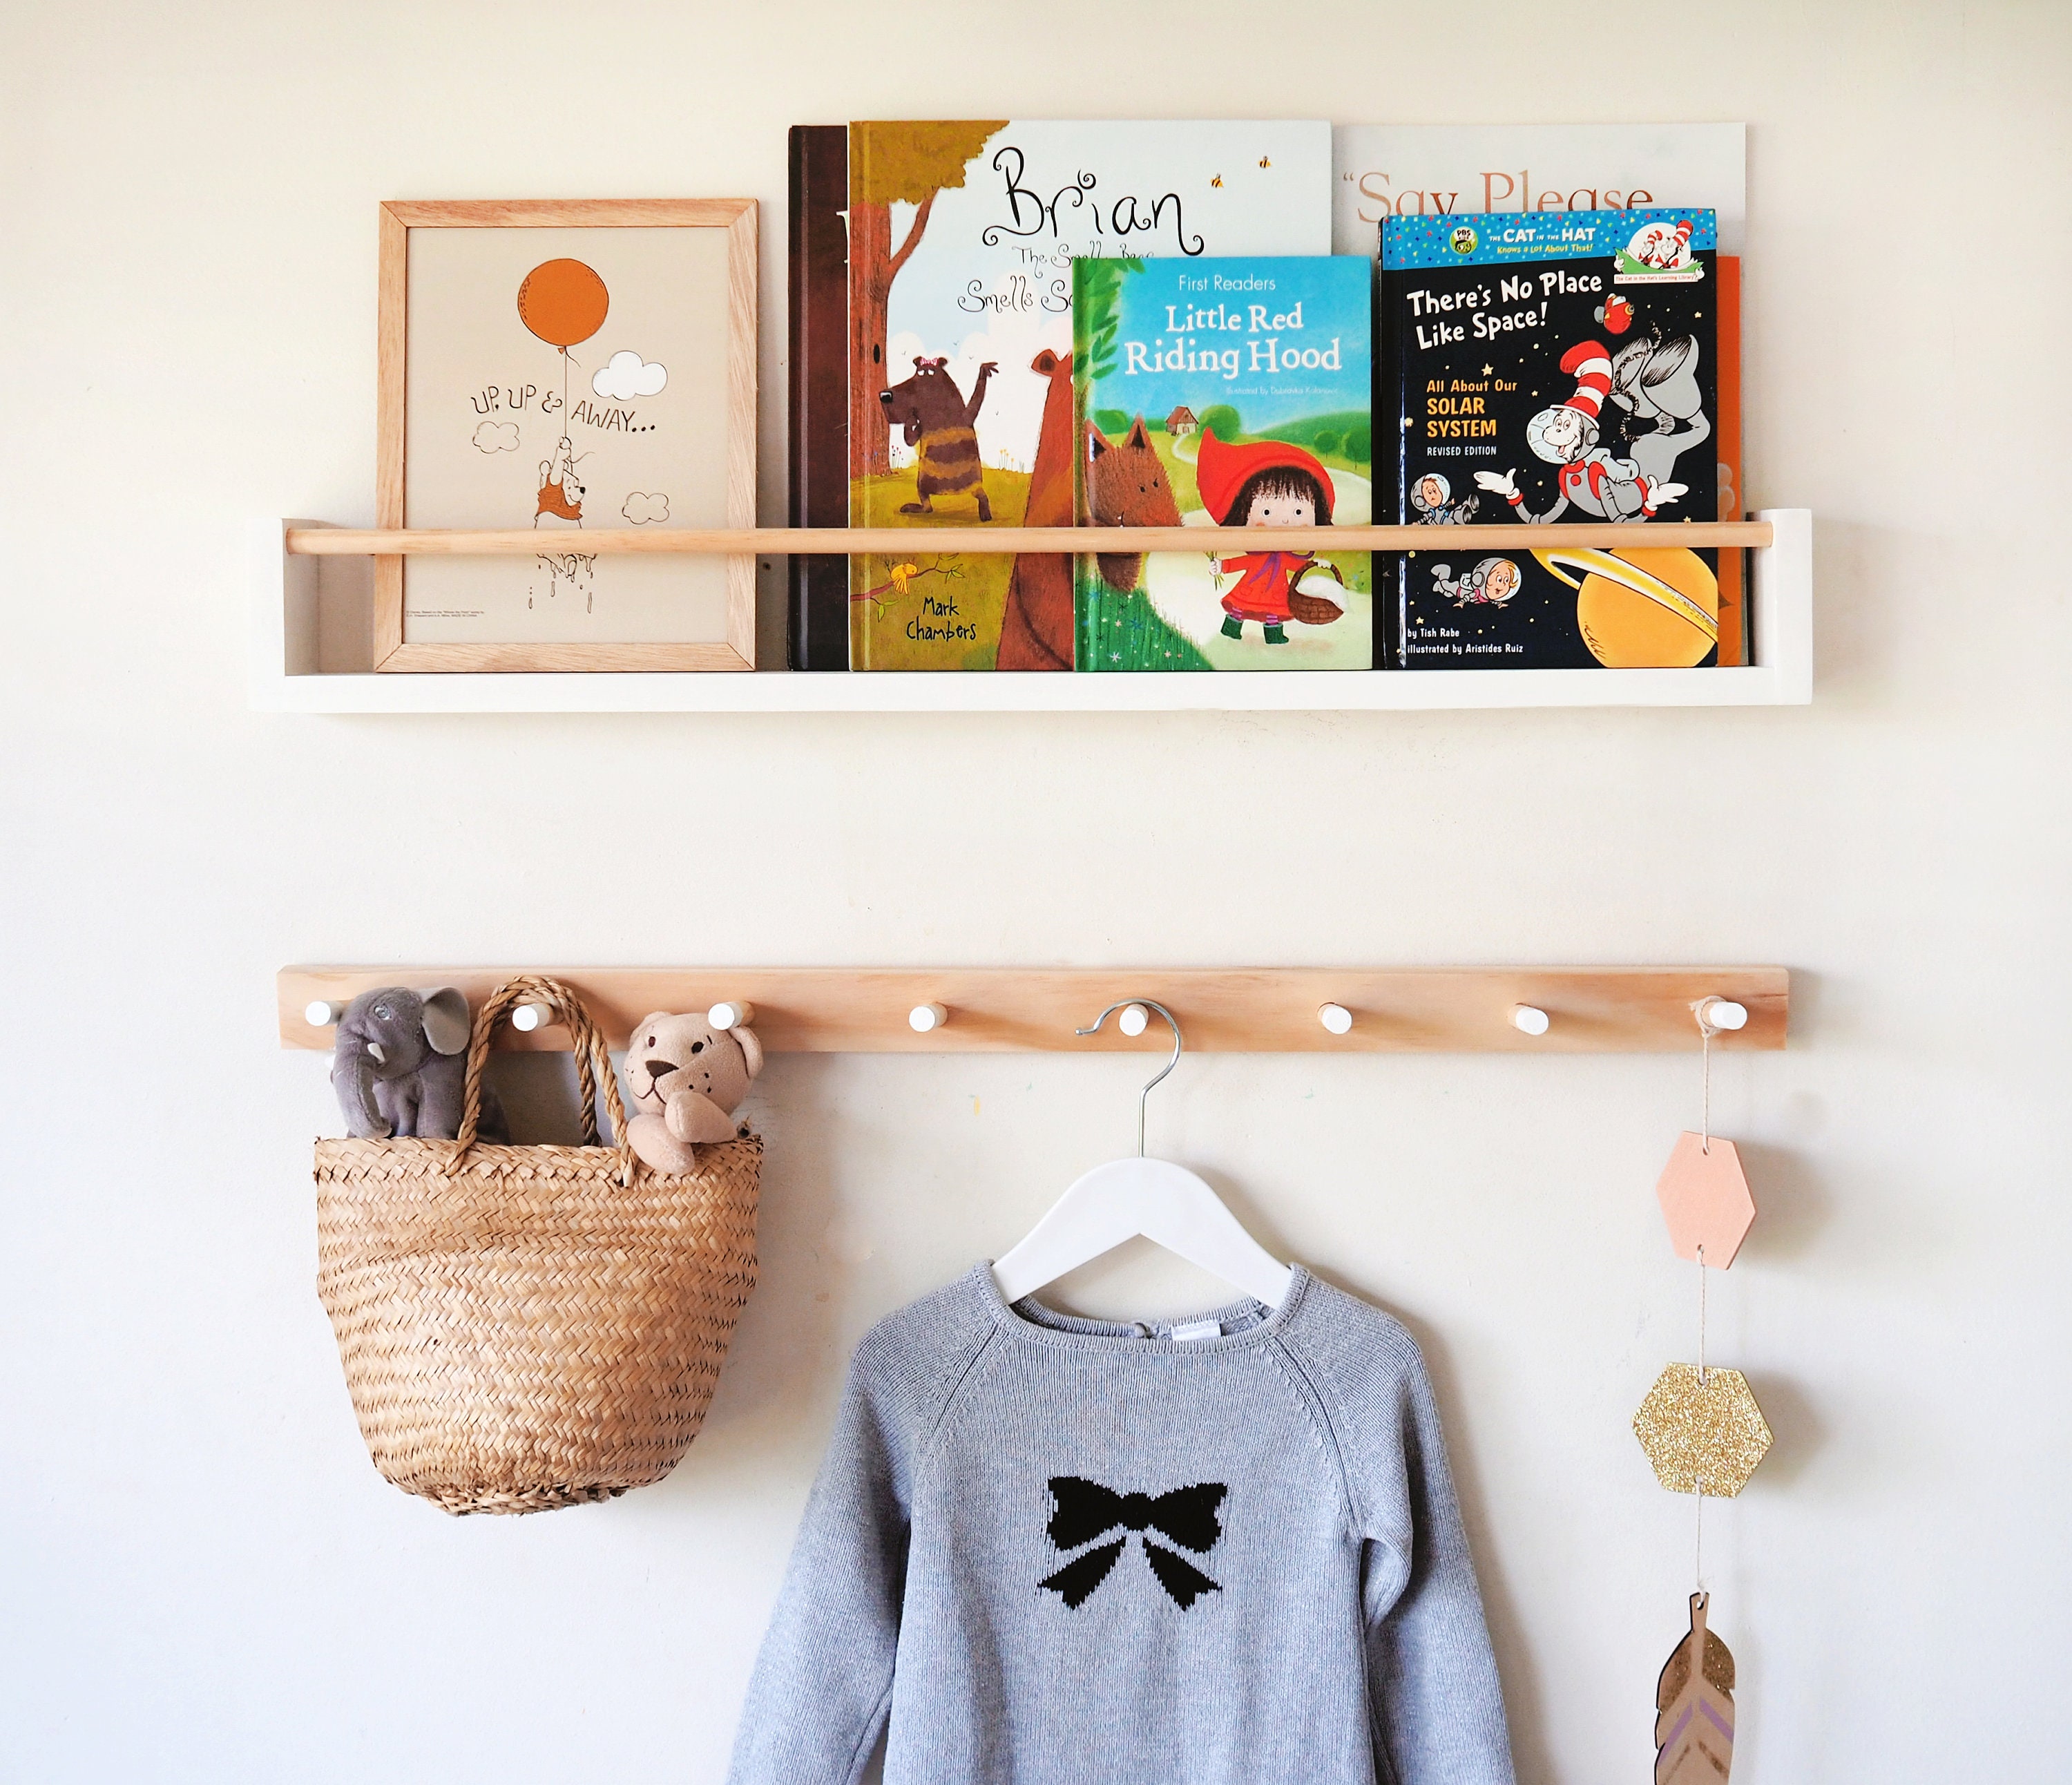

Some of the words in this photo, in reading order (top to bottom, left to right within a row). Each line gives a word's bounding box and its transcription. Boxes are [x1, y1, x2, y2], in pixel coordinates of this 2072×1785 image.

[982, 146, 1204, 256] Brian
[1503, 229, 1537, 242] CAT
[1562, 227, 1595, 241] HAT
[1497, 246, 1522, 254] Knows
[1531, 245, 1542, 254] Lot
[1545, 244, 1568, 253] About
[1012, 246, 1047, 278] The
[1179, 275, 1208, 291] First
[1214, 274, 1276, 291] Readers
[1406, 284, 1491, 316] There's
[1500, 274, 1533, 303] No
[1539, 270, 1602, 296] Place
[957, 276, 1033, 314] Smells
[1165, 303, 1241, 332] Little
[1248, 301, 1304, 333] Red
[1416, 321, 1465, 350] Like
[1473, 301, 1548, 341] Space!
[1124, 336, 1240, 379] Riding
[1247, 337, 1343, 373] Hood
[1426, 380, 1443, 392] All
[1450, 379, 1488, 392] About
[1495, 379, 1517, 391] Our
[508, 385, 536, 410] UP
[541, 391, 563, 413] &
[1427, 397, 1485, 415] SOLAR
[1427, 419, 1497, 438] SYSTEM
[1427, 446, 1461, 456] REVISED
[1465, 446, 1497, 455] EDITION
[922, 595, 959, 616] Mark
[906, 615, 976, 642] Chambers
[1408, 629, 1417, 639] by
[1420, 628, 1437, 638] Tish
[1440, 628, 1459, 638] Rabe
[1408, 644, 1449, 654] illustrated
[1452, 645, 1461, 655] by
[1466, 643, 1502, 654] Aristides
[1506, 643, 1523, 653] Ruiz
